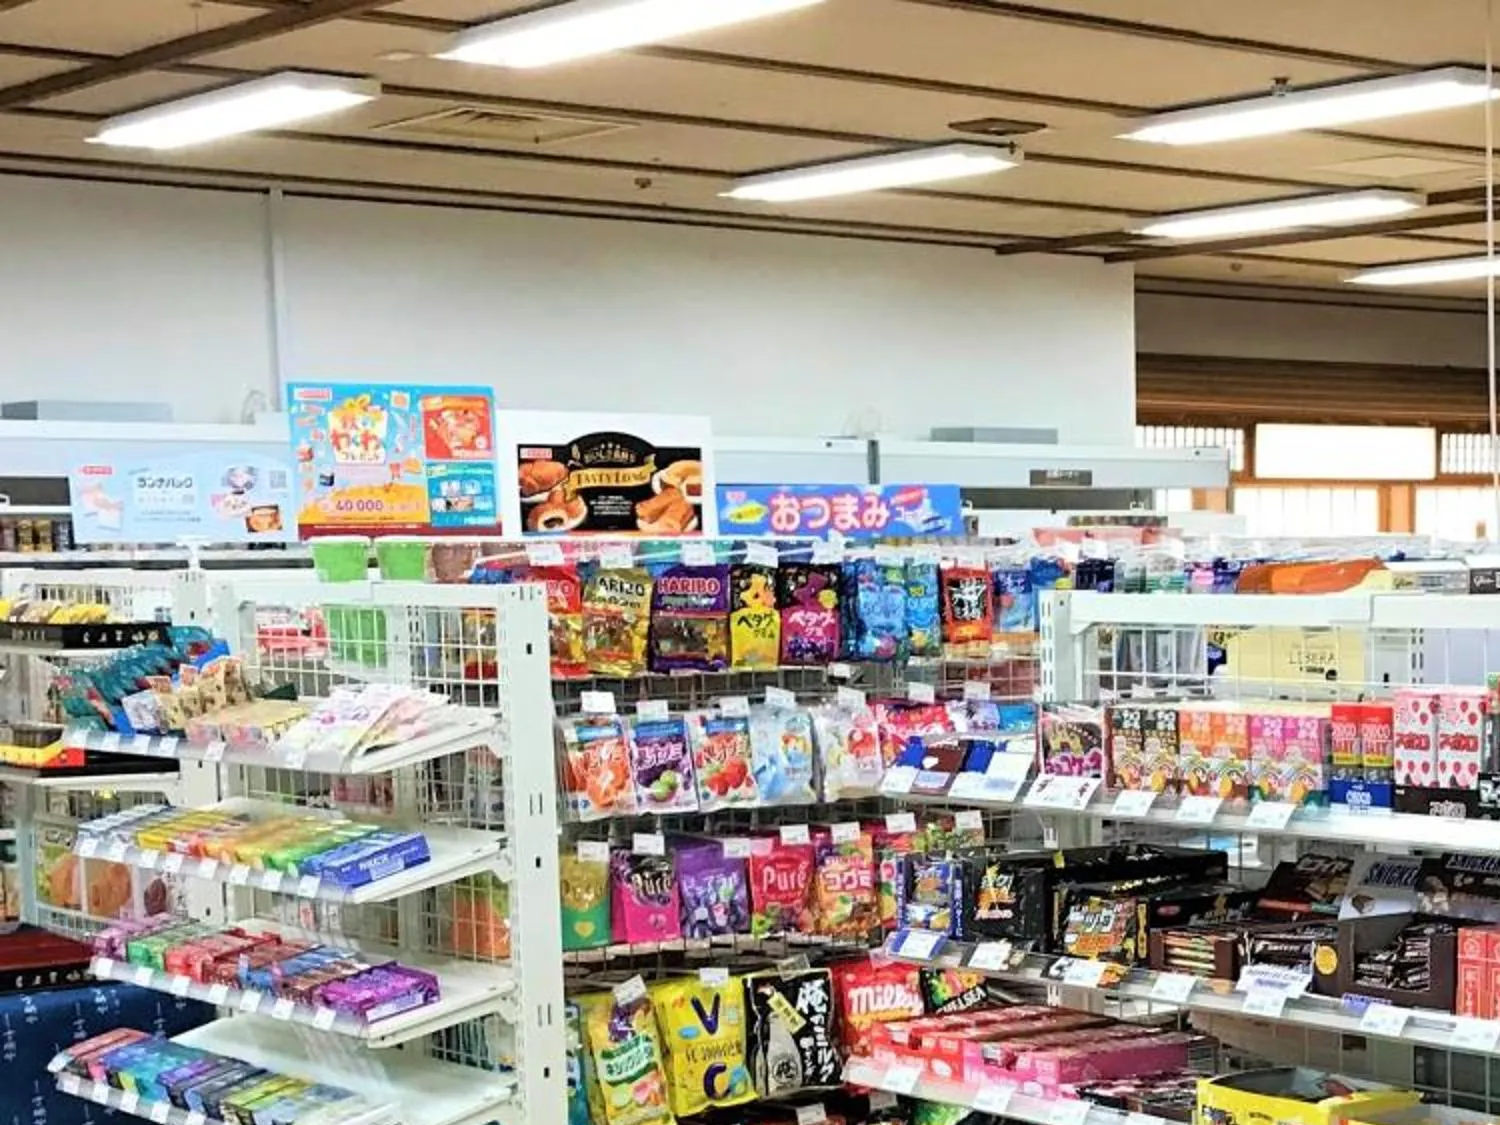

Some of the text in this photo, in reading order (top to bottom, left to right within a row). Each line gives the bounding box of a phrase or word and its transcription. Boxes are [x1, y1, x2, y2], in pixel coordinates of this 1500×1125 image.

[769, 494, 890, 532] おつまみ
[657, 577, 720, 595] HARIBO
[1438, 732, 1479, 752] アポロ
[691, 992, 721, 1035] V
[850, 984, 925, 1016] Milky
